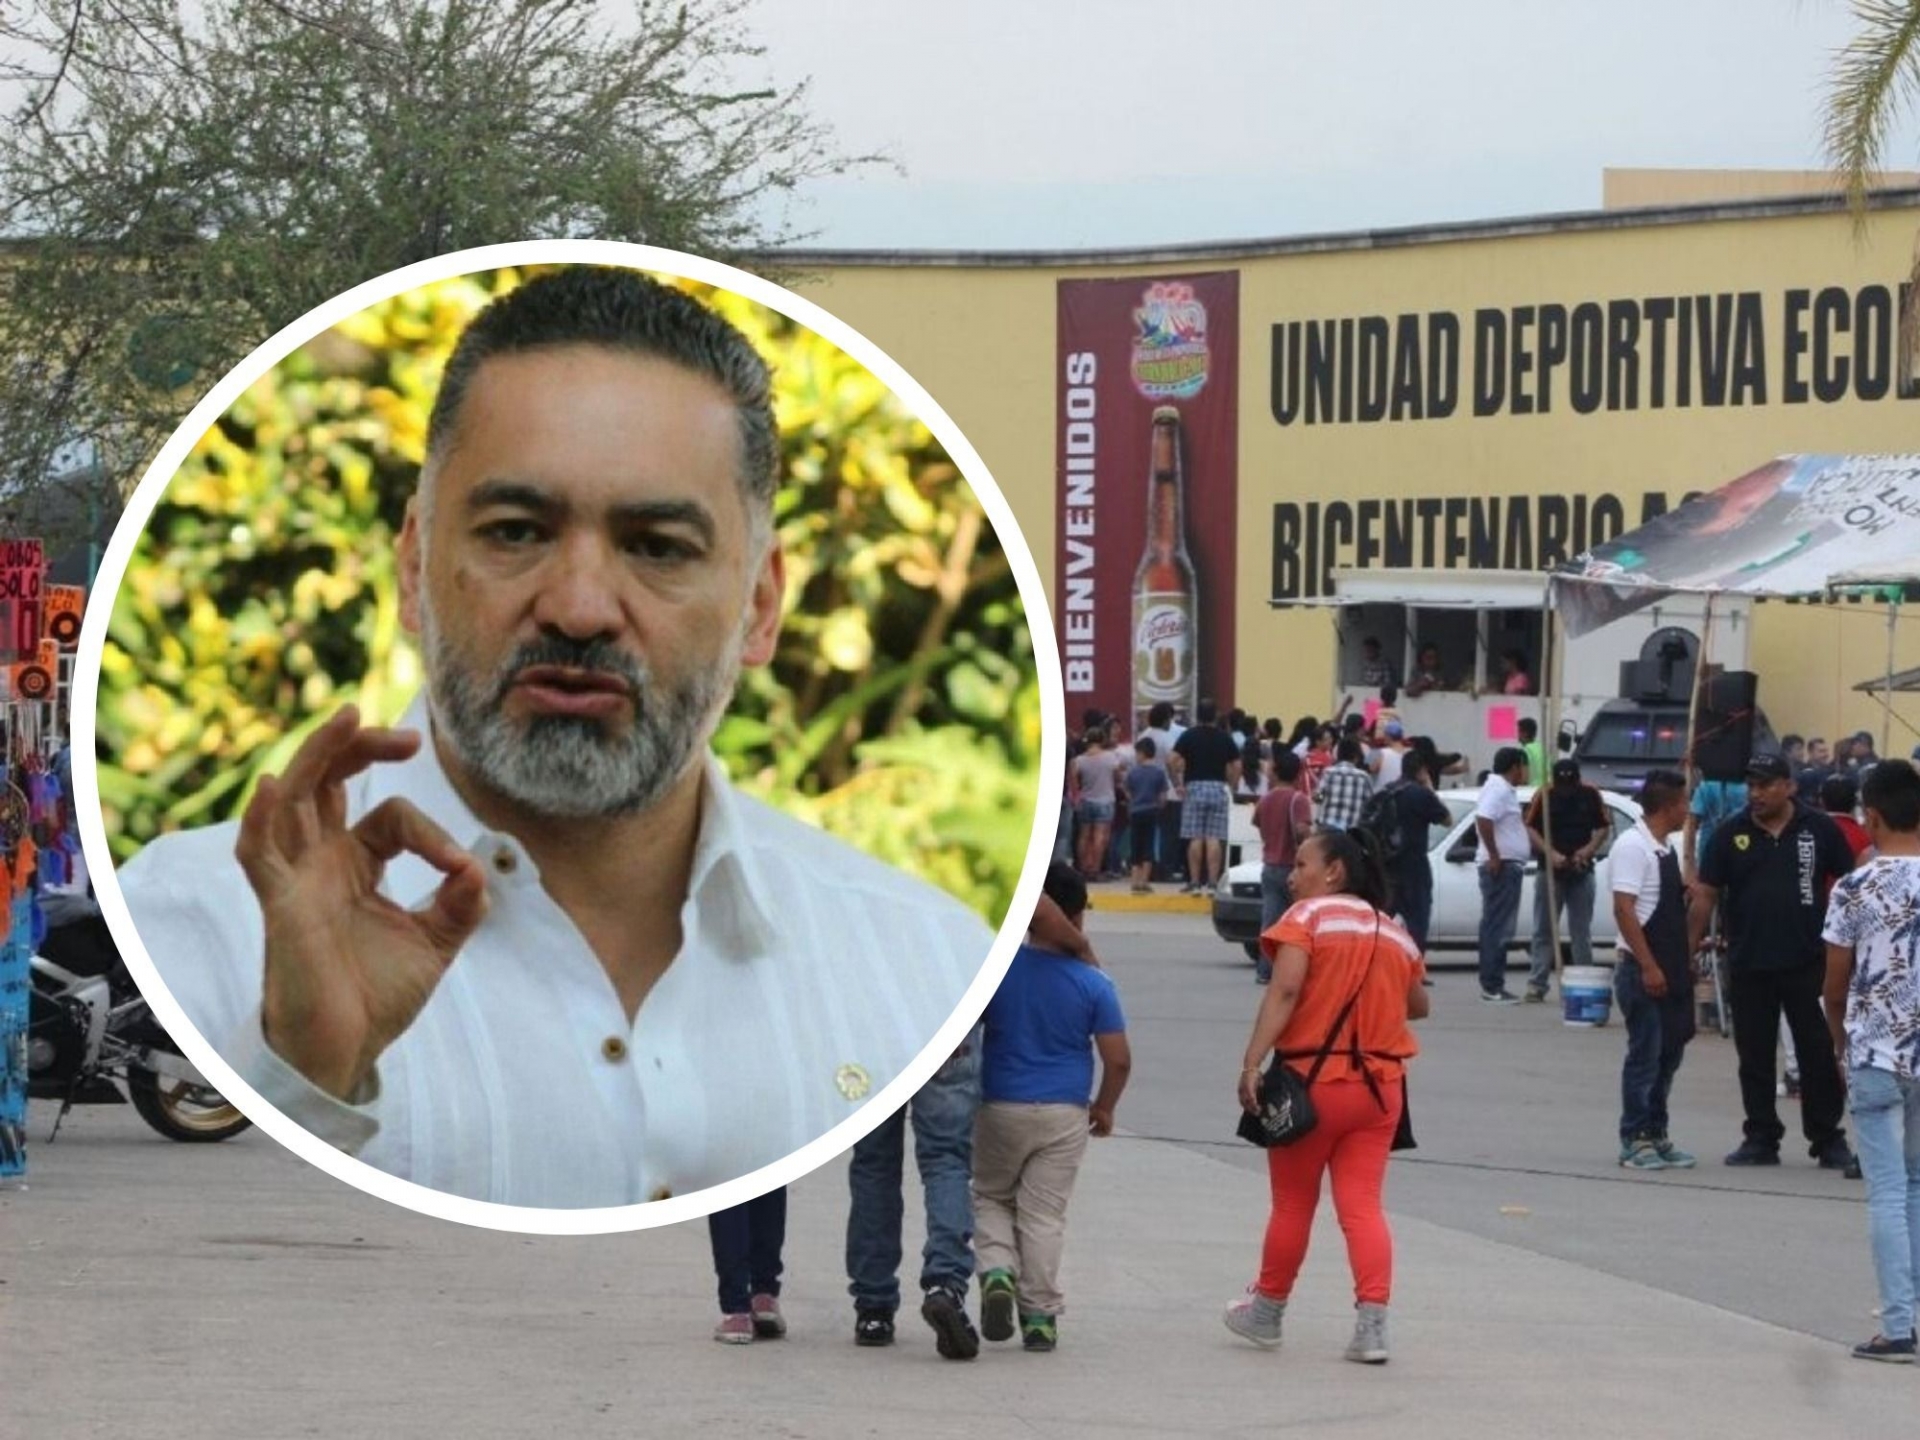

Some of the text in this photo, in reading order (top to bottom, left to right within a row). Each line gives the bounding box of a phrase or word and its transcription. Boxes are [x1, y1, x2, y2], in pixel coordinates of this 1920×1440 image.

[1271, 311, 1460, 427] UNIDAD
[1473, 291, 1768, 417] DEPORTIVA
[1066, 352, 1097, 692] BIENVENIDOS
